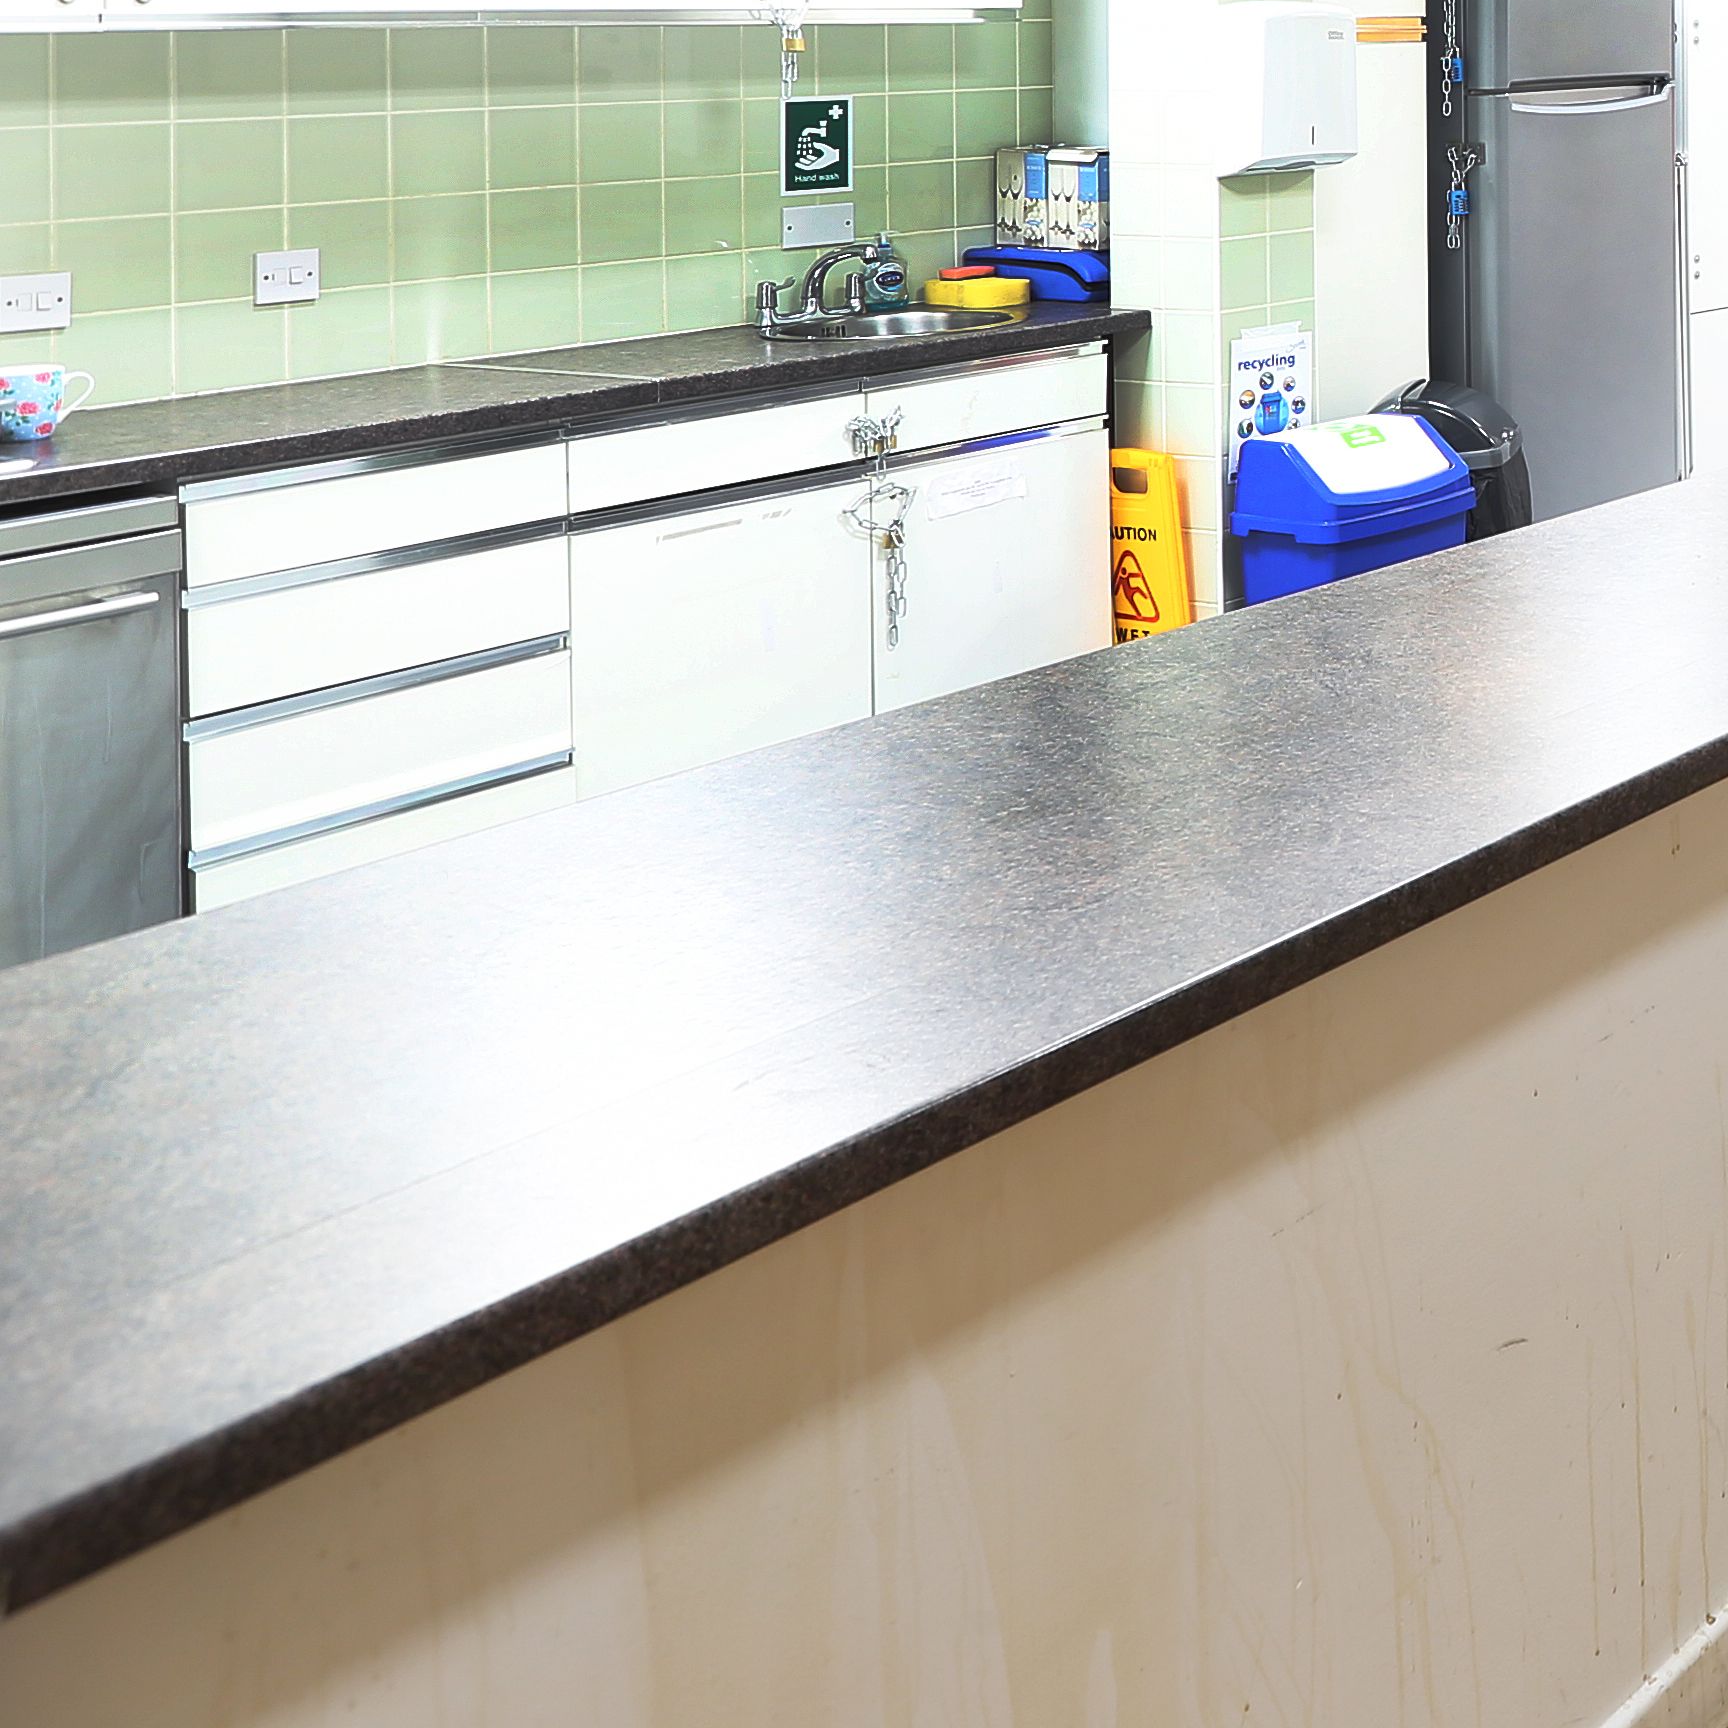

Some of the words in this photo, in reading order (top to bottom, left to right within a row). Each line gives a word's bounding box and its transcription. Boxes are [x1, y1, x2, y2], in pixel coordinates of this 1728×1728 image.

[794, 173, 817, 183] Hand
[818, 172, 840, 181] wash
[1237, 353, 1296, 372] recycling
[1111, 525, 1157, 542] UTION
